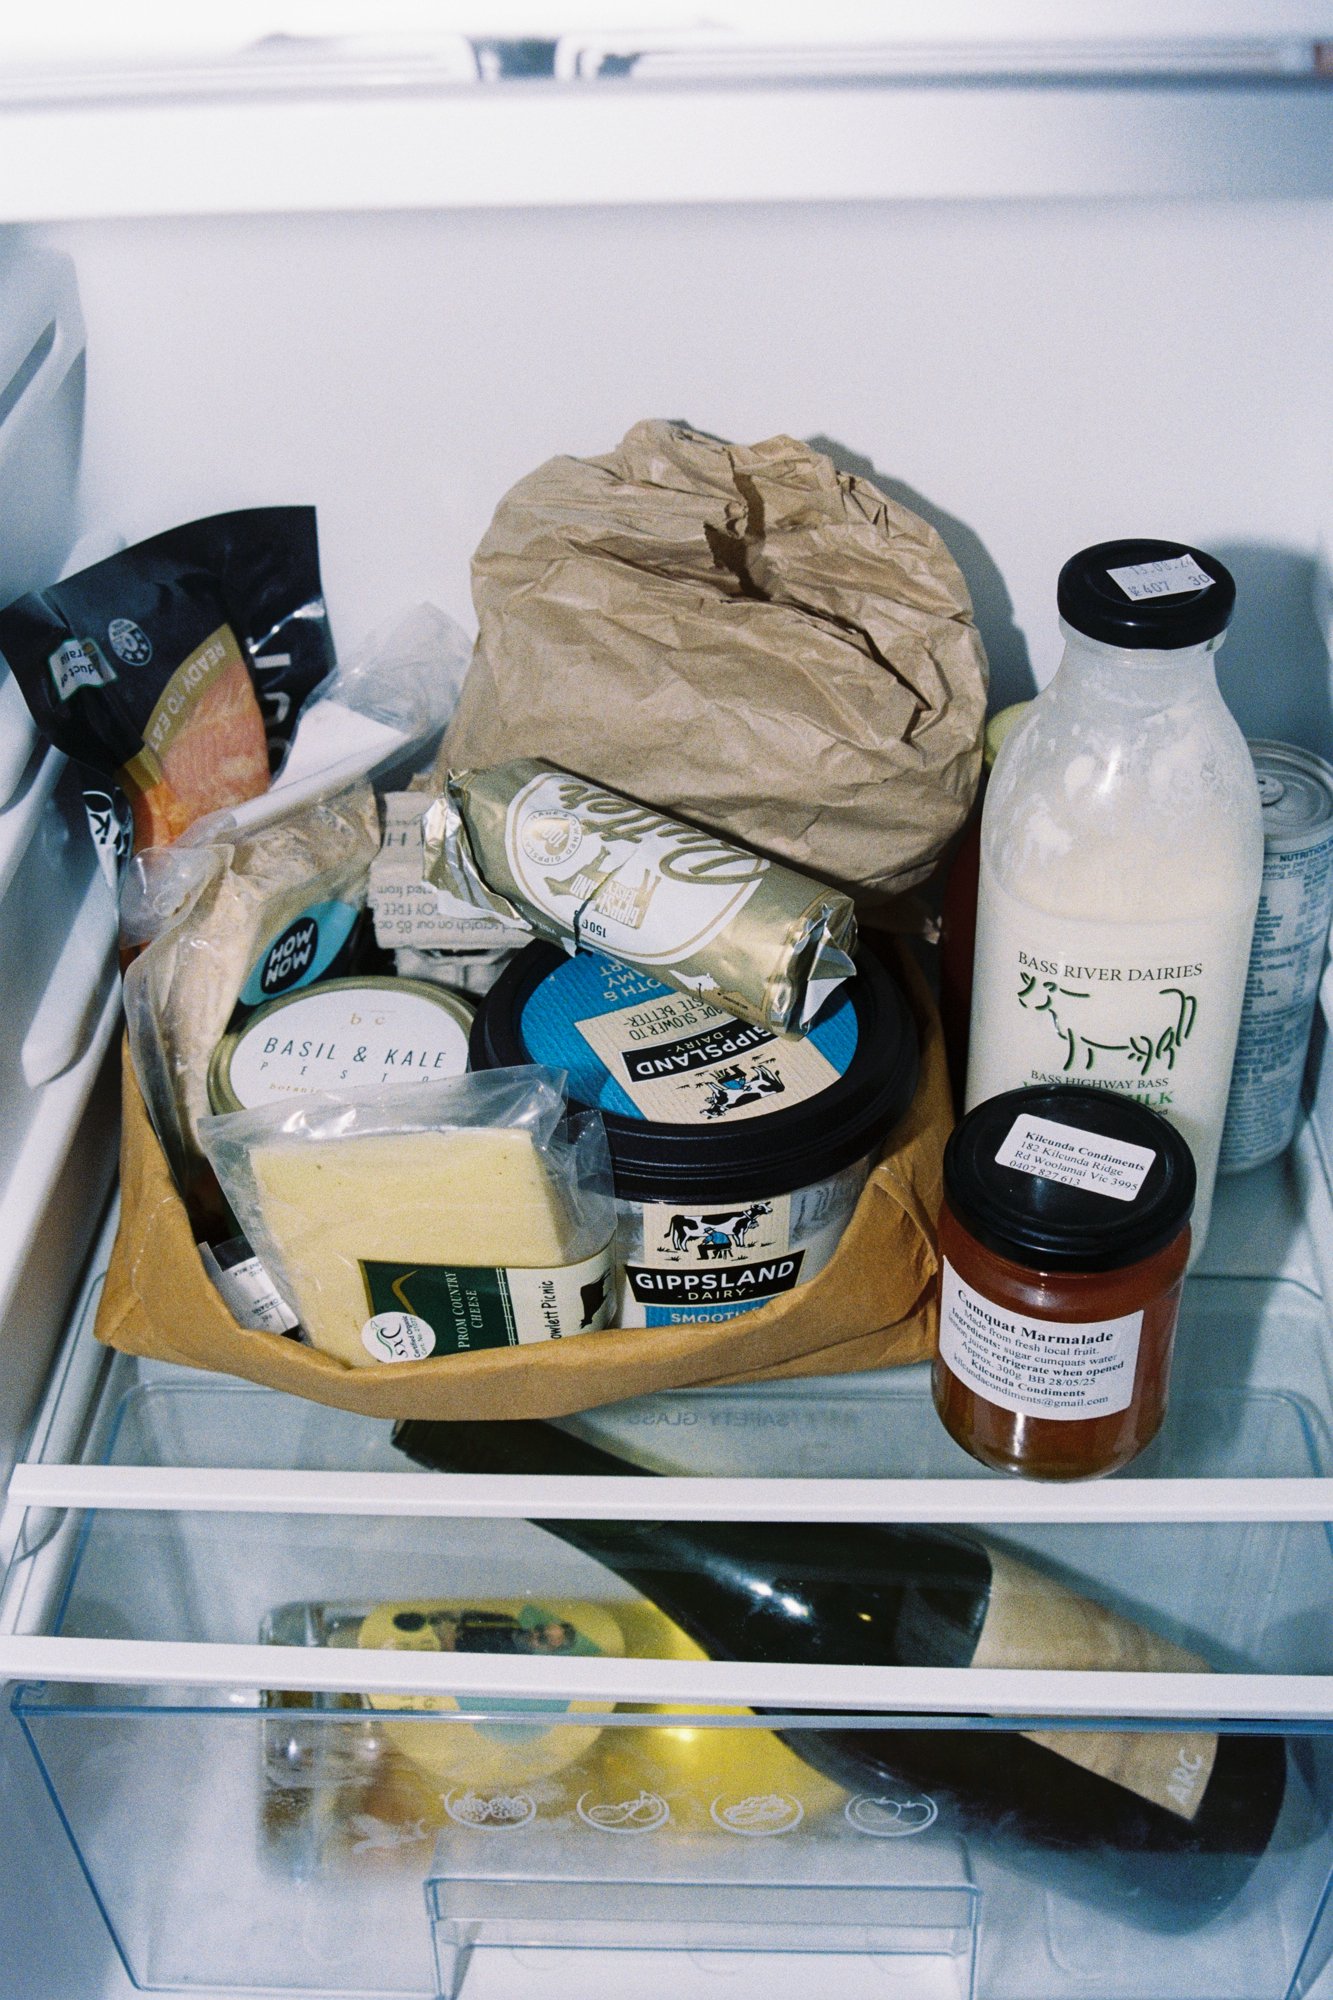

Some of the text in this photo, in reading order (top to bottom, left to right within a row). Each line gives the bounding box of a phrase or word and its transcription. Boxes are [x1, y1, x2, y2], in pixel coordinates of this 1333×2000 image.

[1188, 574, 1210, 586] 30
[69, 664, 94, 677] duct
[149, 641, 226, 751] READY TO EAT
[376, 886, 402, 895] from
[384, 903, 412, 916] FREE
[396, 921, 412, 933] 85
[417, 921, 437, 930] our
[438, 922, 454, 930] on
[455, 921, 499, 933] scratch
[269, 923, 314, 967] HOW
[265, 944, 312, 987] NOW
[1018, 951, 1203, 981] BASS RIVER DAIRIES
[603, 990, 618, 1002] &
[677, 996, 705, 1014] STE
[629, 1027, 648, 1041] TO
[650, 1012, 698, 1036] SLOWER
[263, 1037, 447, 1068] BASIL & KALE
[636, 1025, 772, 1075] GIPPSLAND
[1031, 1070, 1169, 1089] BASS HIGHWAY BASS
[1127, 1092, 1173, 1105] ILK
[1021, 1141, 1124, 1177] 182 Kilcunda Ridge
[1026, 1132, 1145, 1171] Kilcunda Condiments
[1009, 1160, 1081, 1186] 0407 827 613
[1015, 1150, 1139, 1191] Rd Woolamai Vic 3995
[635, 1261, 794, 1290] GIPPSLAND
[445, 1271, 470, 1348] PROM COUNTRY
[466, 1290, 484, 1329] CHEESE
[538, 1280, 562, 1340] owlett Picnic
[958, 1290, 1114, 1345] Cumquat Marmalade
[952, 1307, 1117, 1368] Ingredients: sugar cumquats water
[964, 1309, 987, 1330] Made
[989, 1327, 1011, 1344] from
[1015, 1339, 1040, 1352] fresh
[1044, 1346, 1070, 1356] local
[968, 1335, 989, 1353] juice
[991, 1351, 1050, 1375] refrigerate
[1053, 1367, 1083, 1377] when
[1086, 1361, 1124, 1376] opened
[971, 1359, 1086, 1397] Kilcunda Condiments
[998, 1363, 1022, 1380] 300g
[1028, 1374, 1046, 1384] BB
[1049, 1377, 1096, 1387] 28/05/25
